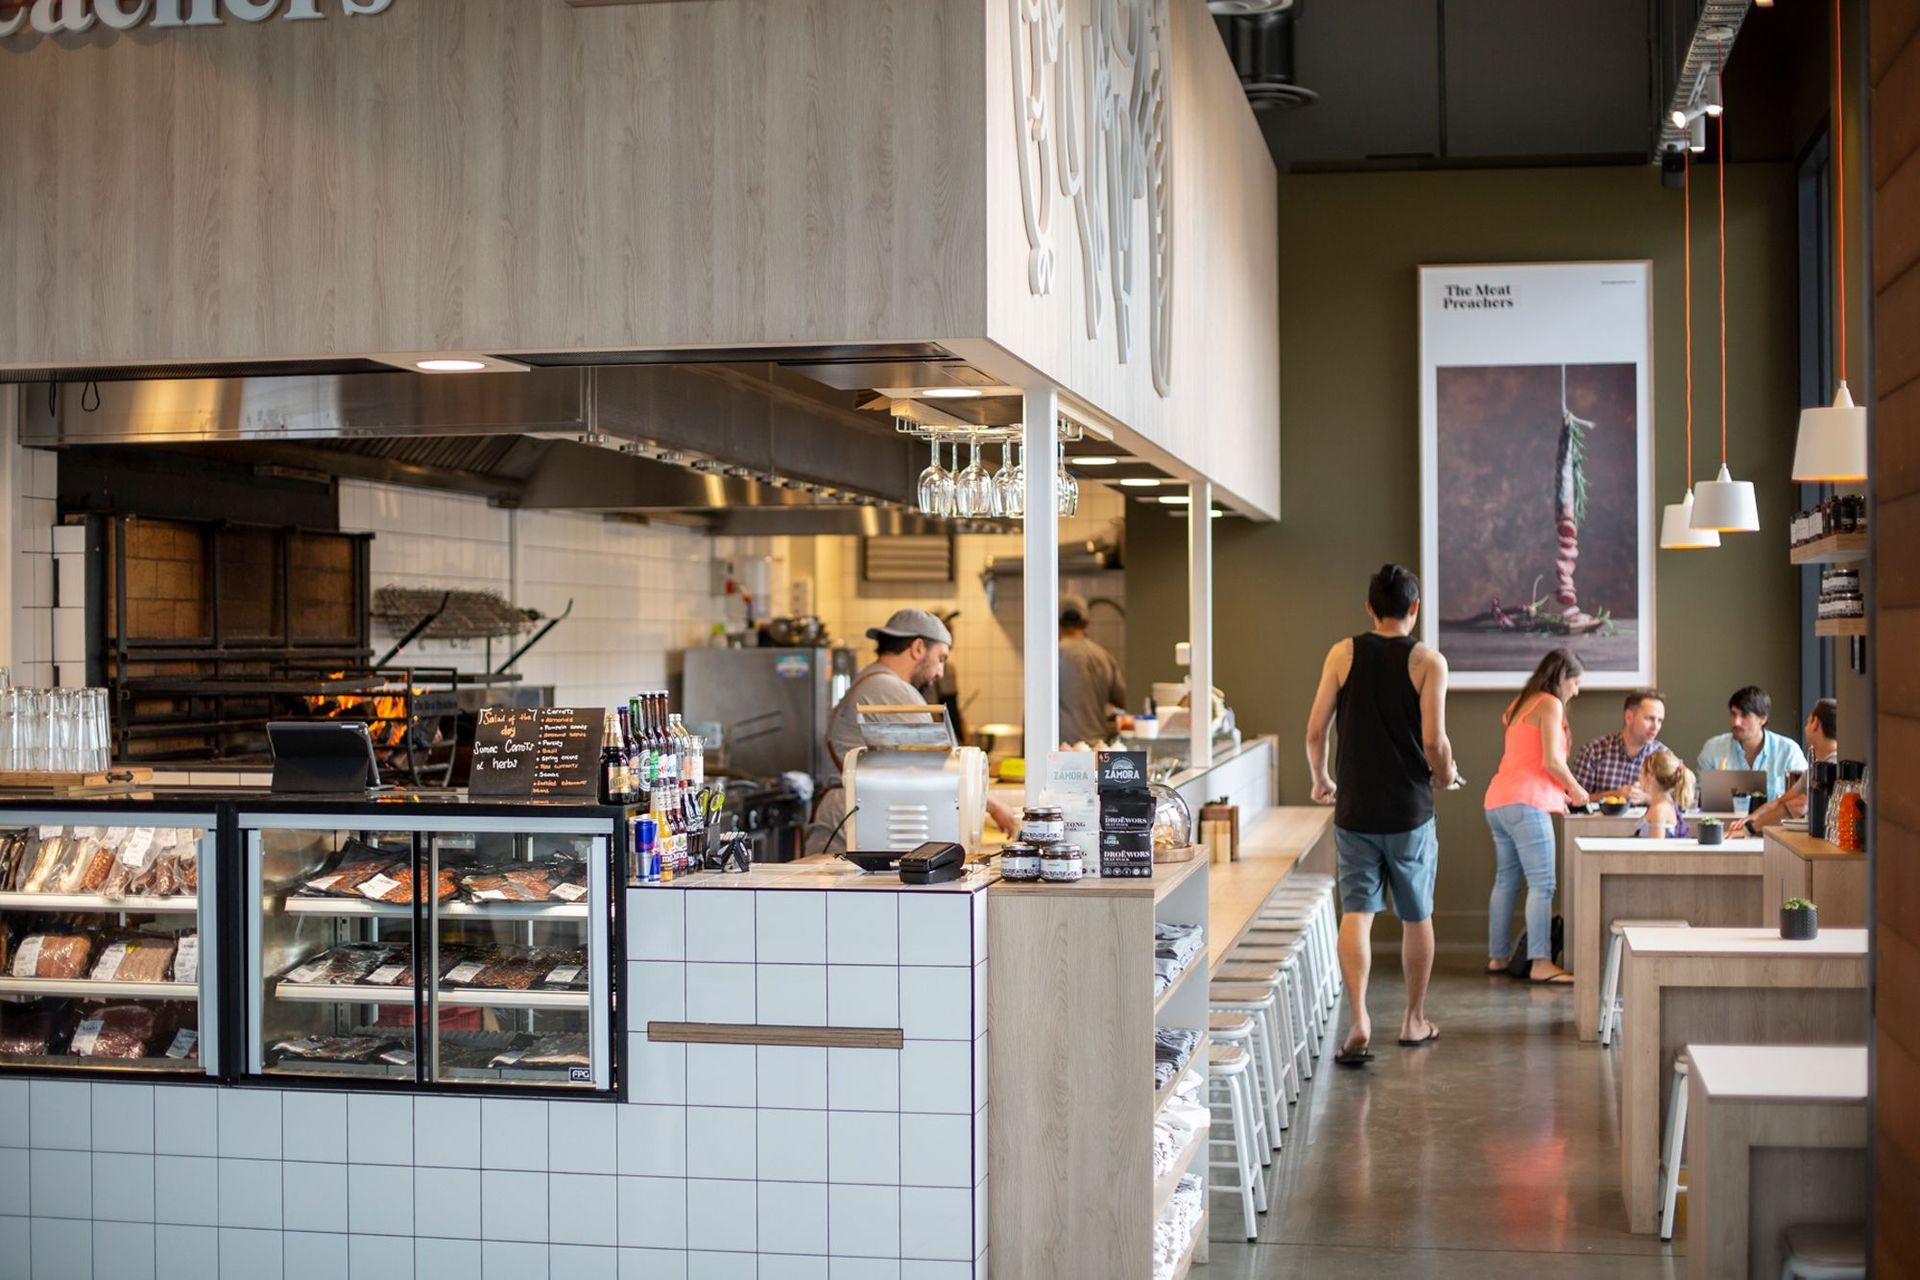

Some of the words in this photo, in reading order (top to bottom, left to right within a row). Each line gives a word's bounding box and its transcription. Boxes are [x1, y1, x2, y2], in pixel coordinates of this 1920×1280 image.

[1445, 284, 1472, 296] The
[1475, 283, 1511, 296] Meat
[1443, 297, 1514, 310] Preachers
[492, 757, 518, 770] herbs
[1054, 770, 1089, 781] ZAMORA
[1104, 769, 1141, 780] ZAMORA
[572, 1070, 590, 1078] FPG
